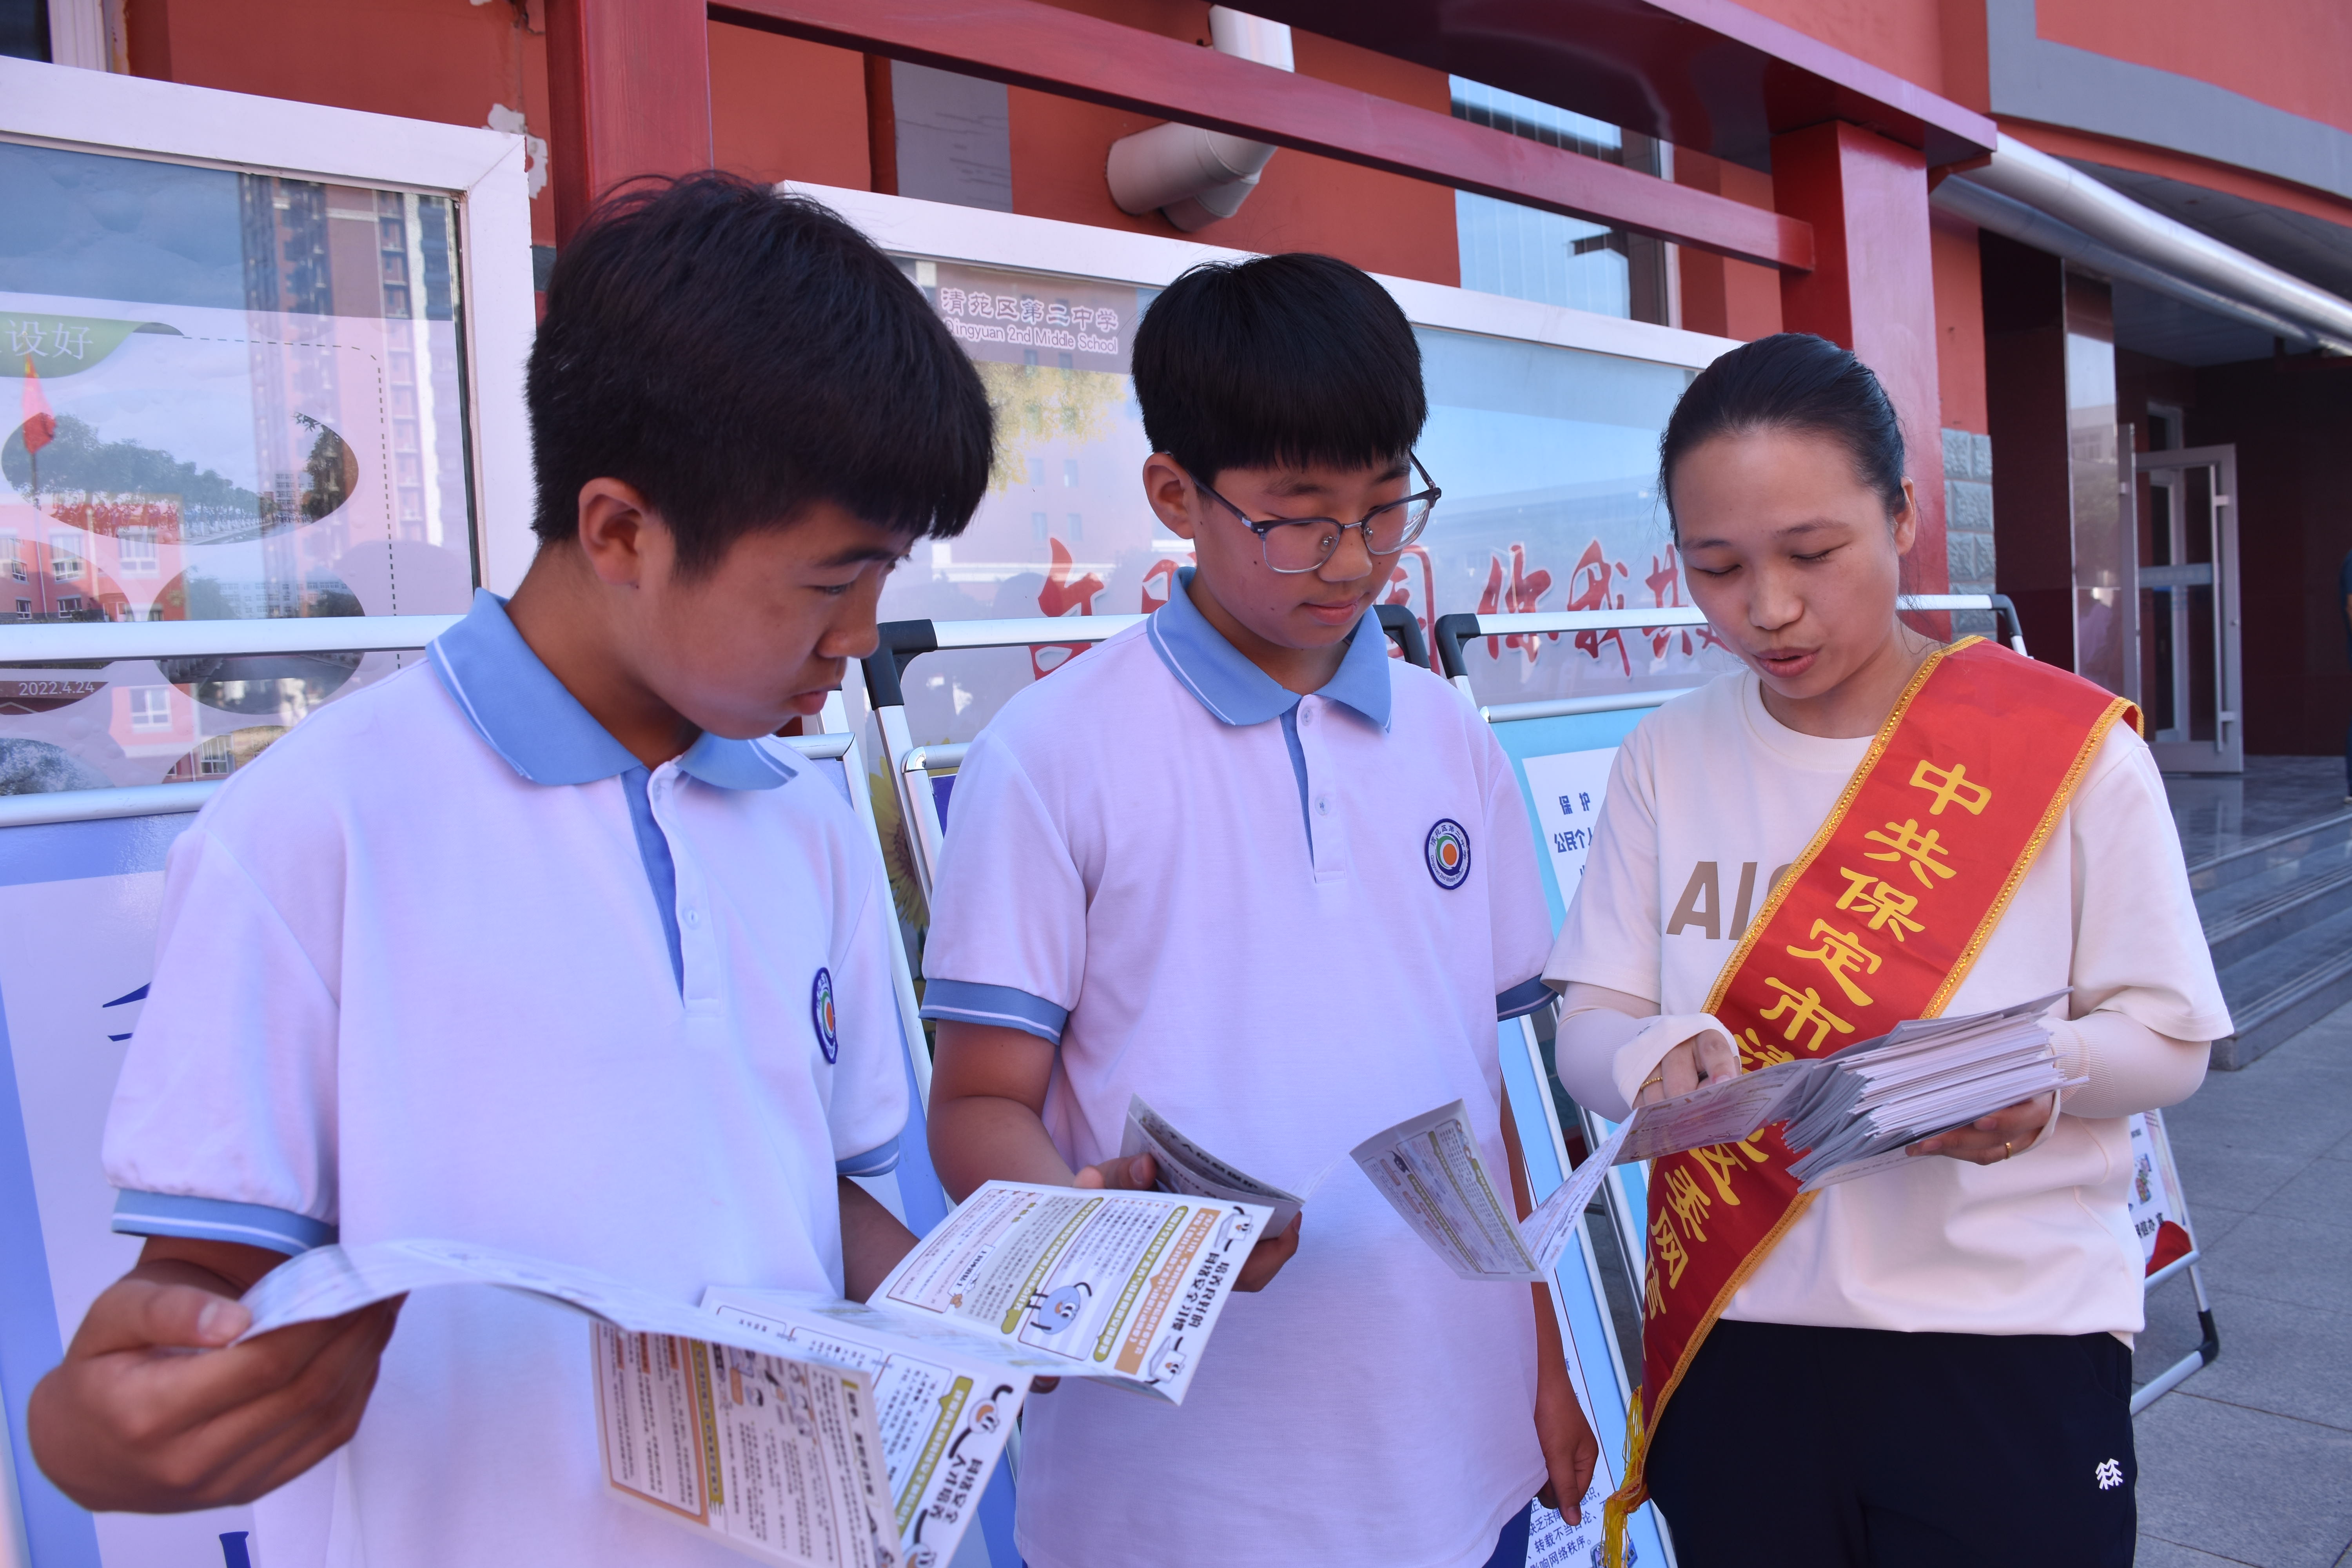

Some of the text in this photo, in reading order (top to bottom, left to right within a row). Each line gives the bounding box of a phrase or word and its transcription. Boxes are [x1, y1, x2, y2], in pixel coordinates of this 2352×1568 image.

[942, 288, 1118, 332] 清苑区第二中学
[0, 319, 93, 360] 设好
[944, 317, 1118, 353] Qingyuan 2nd Middle School
[19, 681, 95, 696] 2022.4.24
[1666, 861, 1793, 940] AI
[1529, 1487, 1600, 1536] 缺乏法律意识，
